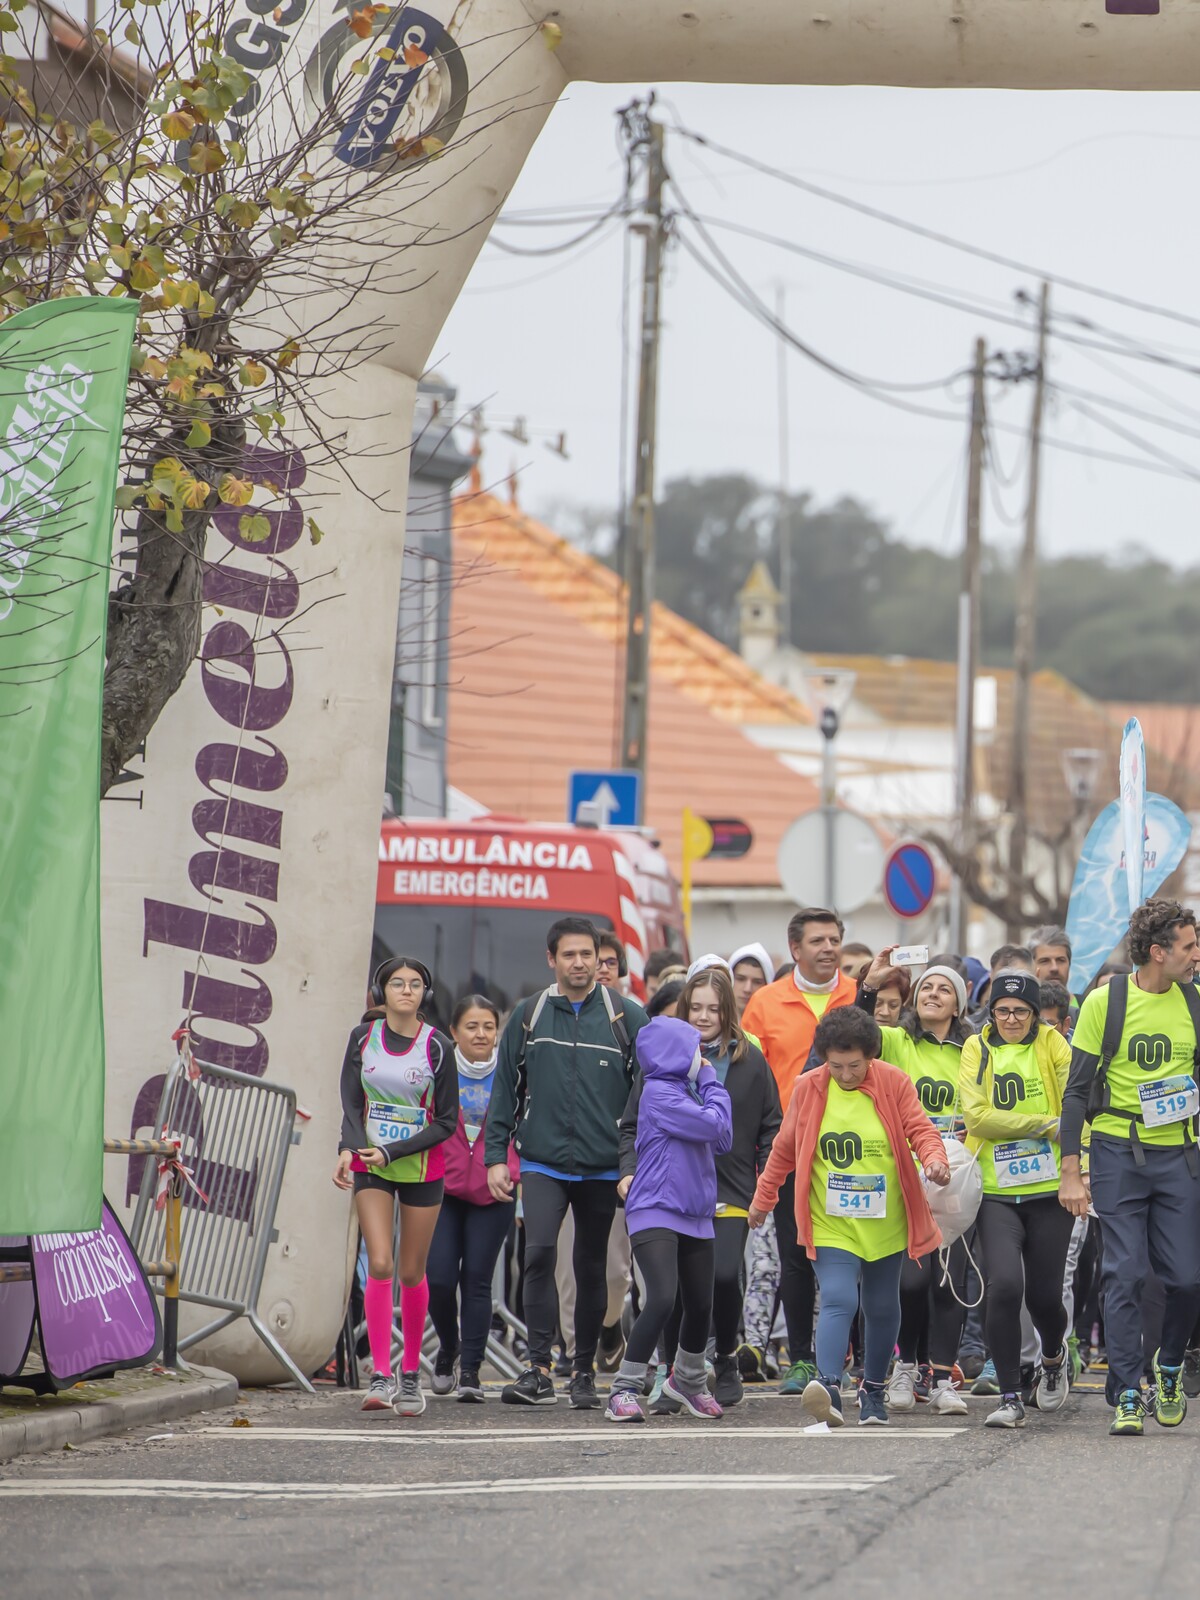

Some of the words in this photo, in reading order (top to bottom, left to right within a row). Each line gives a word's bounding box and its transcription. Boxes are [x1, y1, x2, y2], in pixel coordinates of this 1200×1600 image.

[348, 24, 427, 152] VOLVO
[126, 435, 307, 1237] Palmela
[394, 867, 549, 900] EMERGÊNCIA
[1156, 1095, 1187, 1115] 519
[378, 1123, 410, 1140] 500
[1008, 1157, 1040, 1176] 684
[839, 1193, 871, 1209] 541
[53, 1232, 149, 1331] conquista
